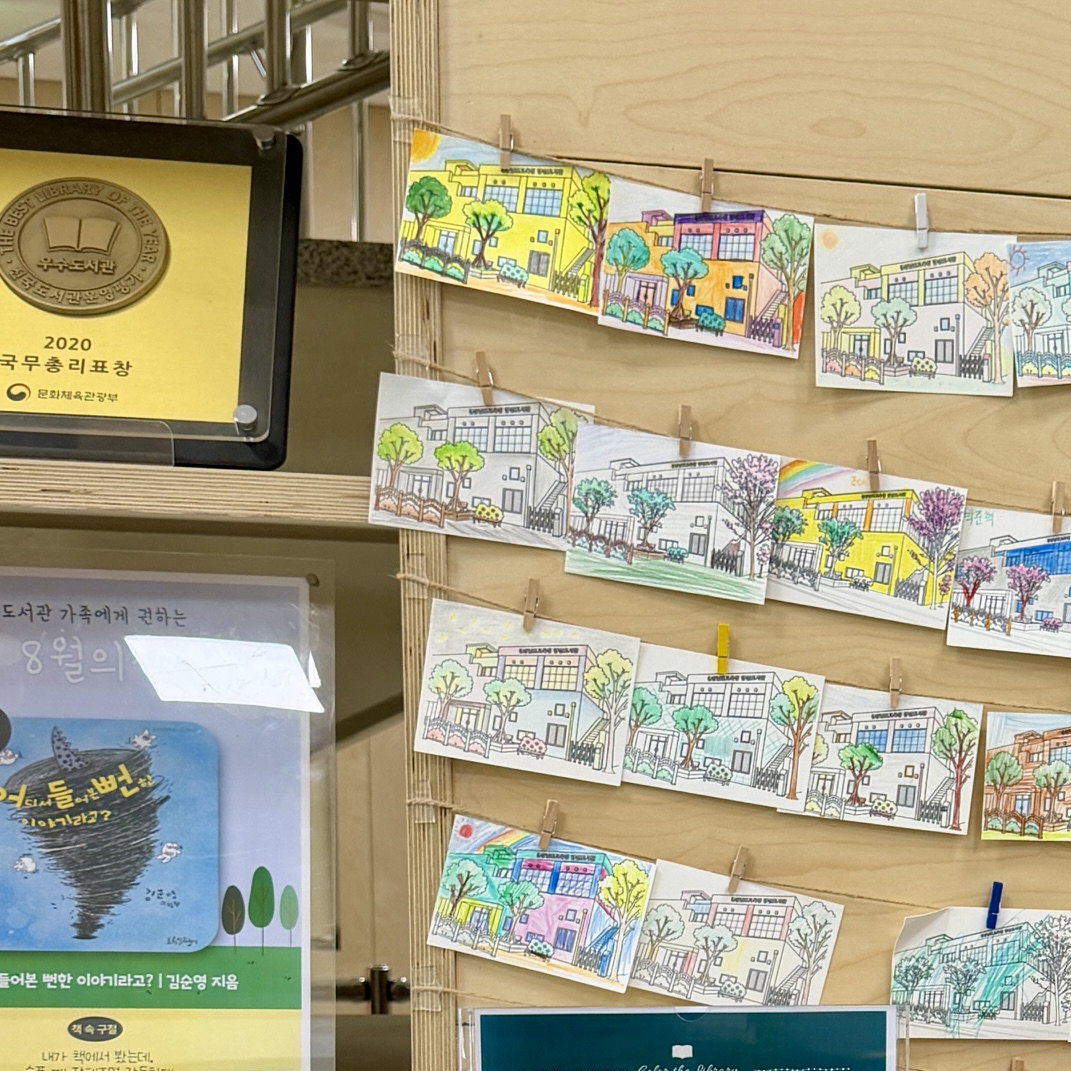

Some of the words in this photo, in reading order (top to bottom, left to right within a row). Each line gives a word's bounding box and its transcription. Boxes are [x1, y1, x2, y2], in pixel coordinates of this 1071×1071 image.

[8, 198, 35, 227] BEST
[34, 184, 104, 203] LIBRARY
[109, 191, 128, 205] OF
[129, 202, 153, 228] THE
[142, 229, 160, 264] YEAR
[37, 257, 117, 274] 우수도서관
[44, 336, 92, 351] 2020
[37, 388, 119, 403] 문화체육관광부
[2, 604, 51, 622] 도서관
[60, 605, 129, 625] 가족에게
[138, 608, 188, 627] 권하는
[22, 636, 125, 683] 8월의
[91, 764, 155, 798] 뻔한
[22, 810, 111, 829] 이야기라고?
[0, 973, 38, 988] 들어본
[42, 973, 73, 988] 뻔한
[77, 973, 153, 989] 이야기라고?
[166, 973, 207, 990] 김순영
[212, 974, 239, 991] 지음
[71, 1023, 83, 1036] 책
[97, 1023, 118, 1036] 구절
[41, 1052, 68, 1062] 내가
[72, 1051, 110, 1063] 책에서
